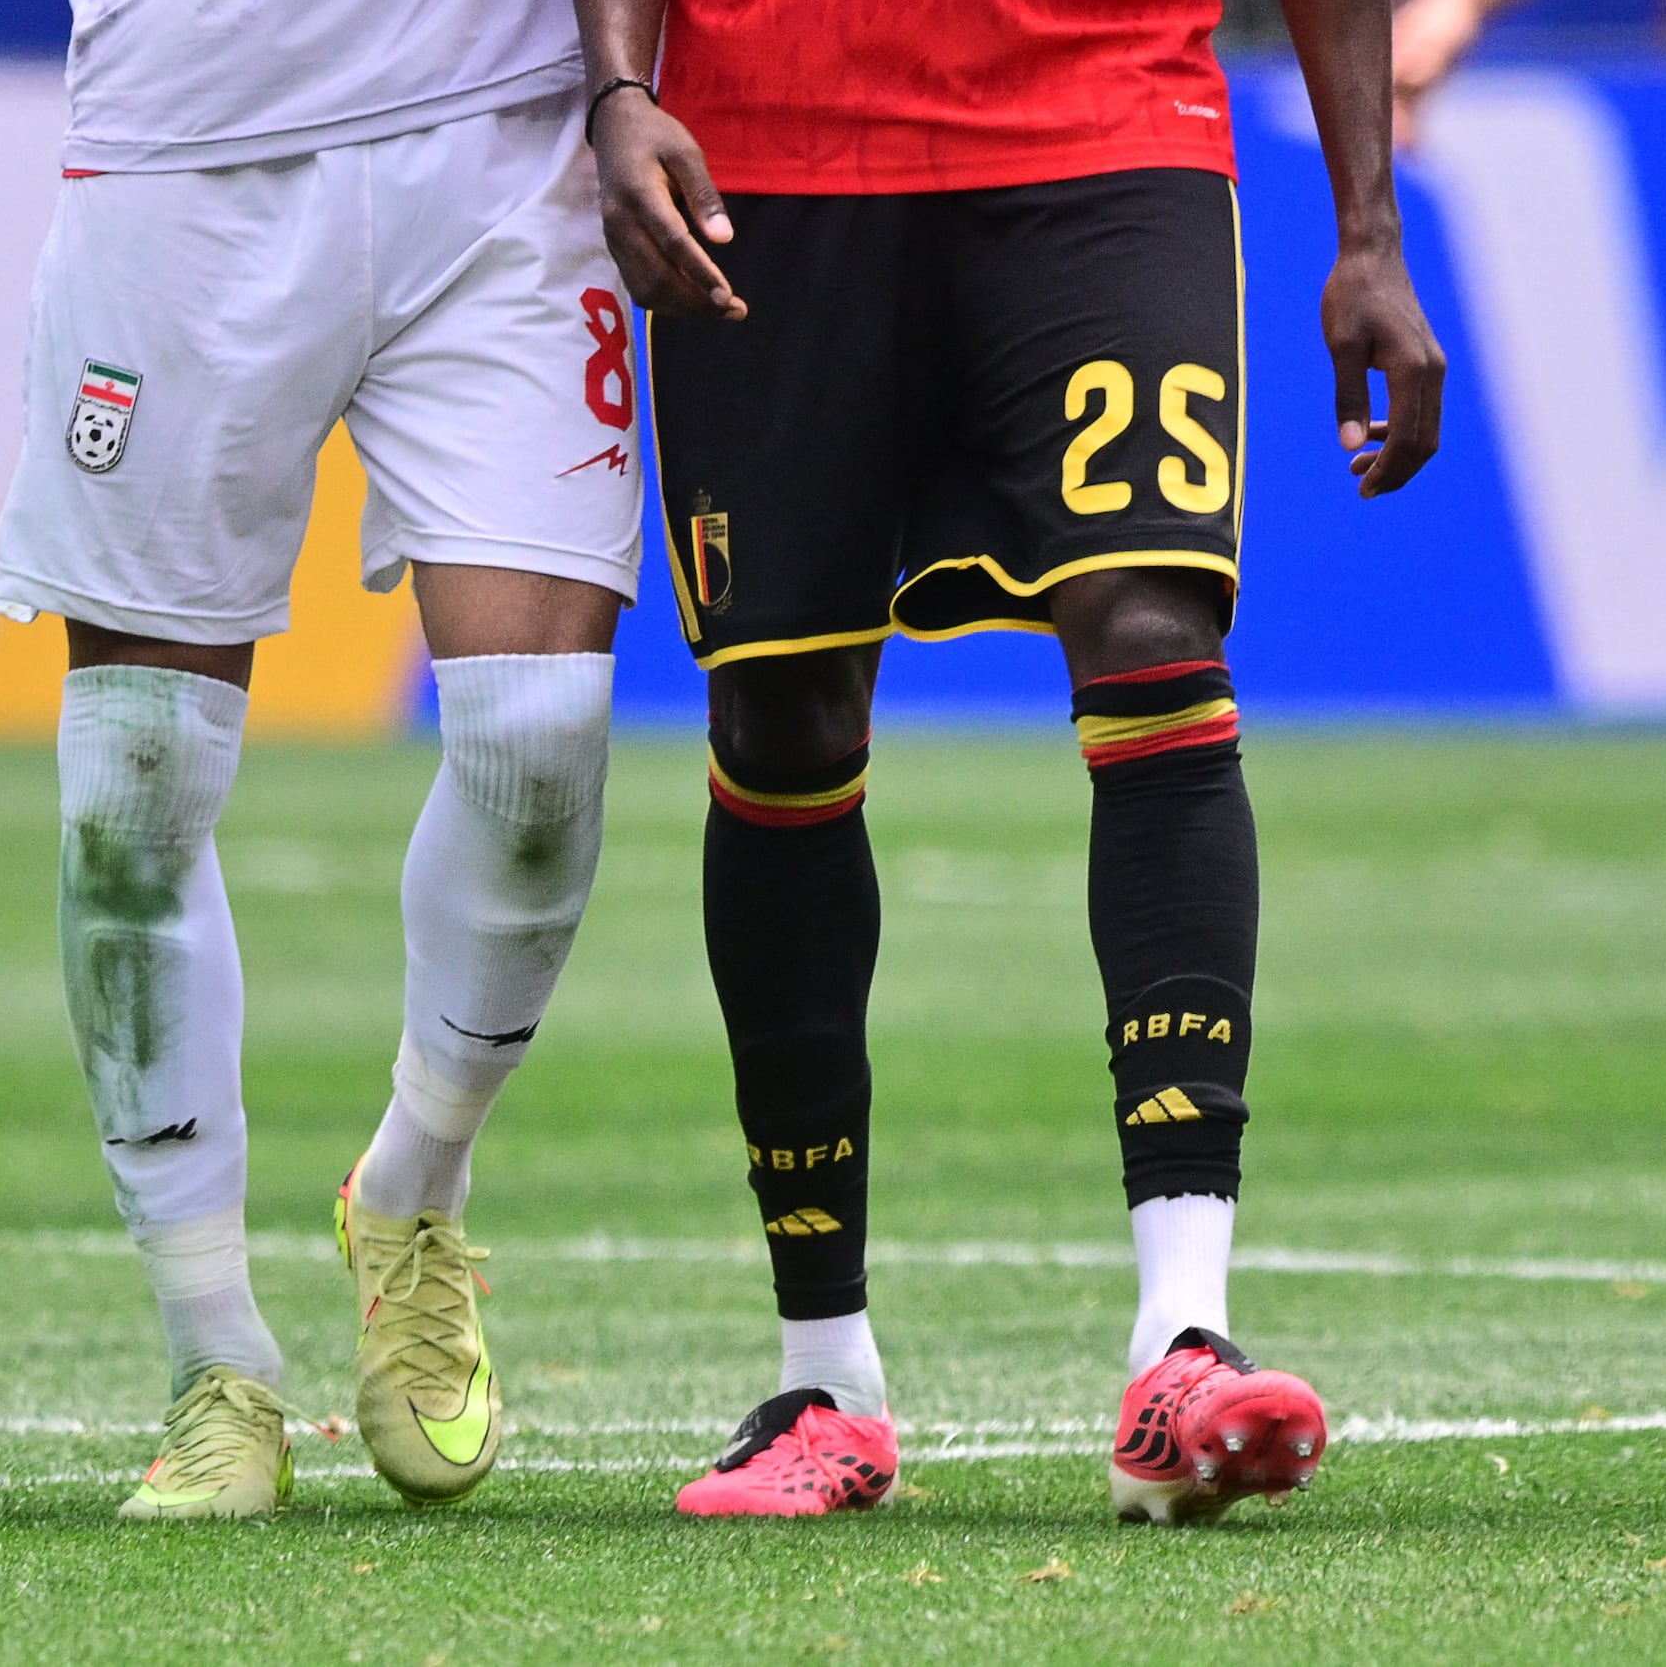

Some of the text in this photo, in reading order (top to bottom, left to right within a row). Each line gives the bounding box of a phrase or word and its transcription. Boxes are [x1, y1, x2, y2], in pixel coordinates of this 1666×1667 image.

[579, 287, 633, 432] 8
[1061, 360, 1230, 514] 25
[1123, 1012, 1231, 1047] RBFA
